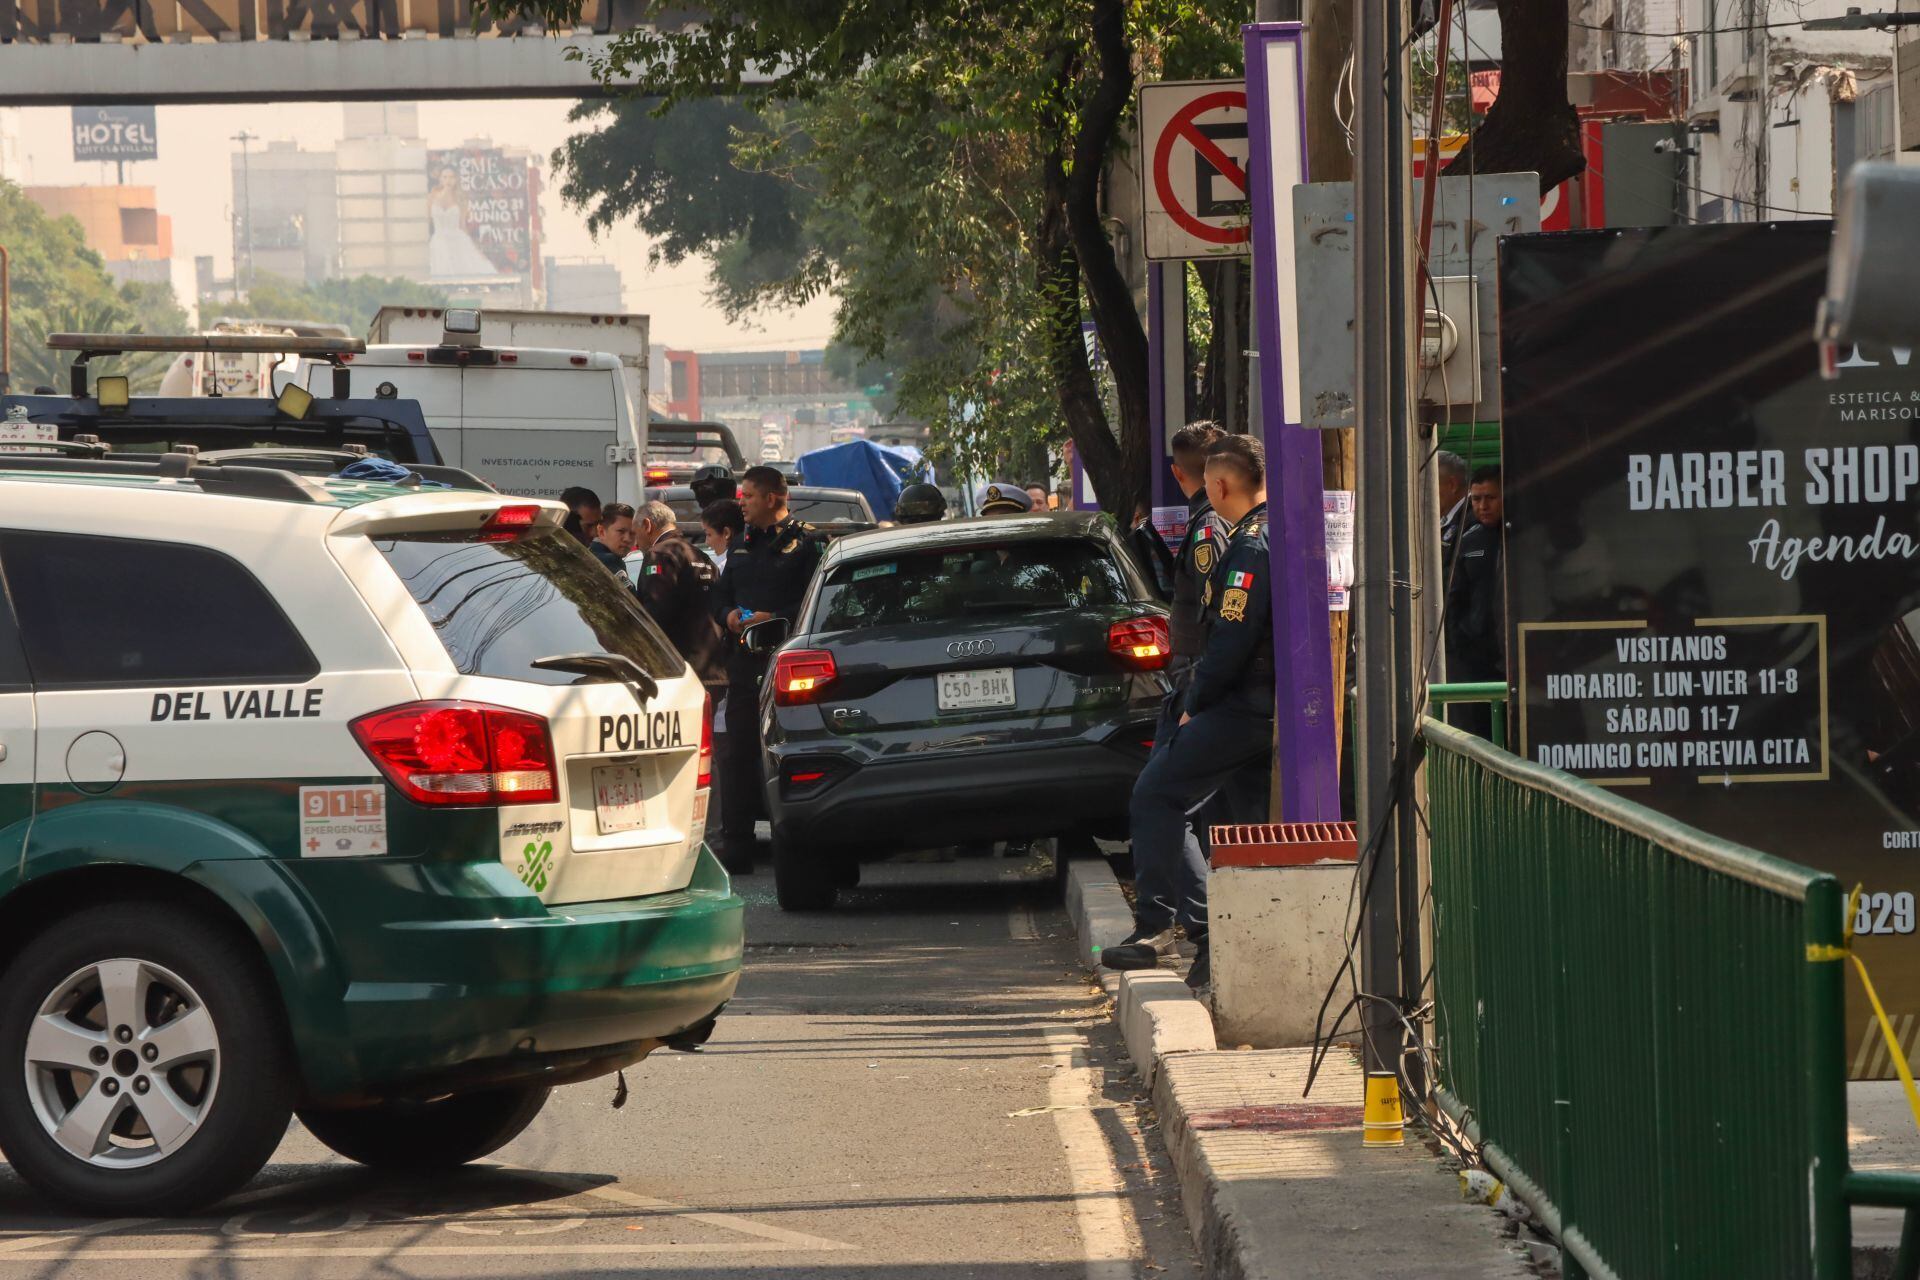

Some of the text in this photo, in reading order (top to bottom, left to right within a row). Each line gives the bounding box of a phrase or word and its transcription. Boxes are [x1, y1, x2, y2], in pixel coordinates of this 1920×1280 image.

[76, 123, 154, 145] HOTEL
[470, 157, 500, 174] ME
[470, 173, 523, 191] CASO
[467, 199, 508, 211] MAYO
[466, 211, 511, 223] JUNIO
[491, 227, 524, 243] WTC
[1829, 391, 1902, 405] ESTETICA
[1841, 407, 1920, 421] MARISOL
[481, 457, 594, 468] INVESTIGACIÓN FORENSE
[535, 473, 541, 481] Y
[1627, 445, 1919, 510] BARBER SHOP
[1748, 515, 1919, 581] Agenda
[1616, 635, 1727, 663] VISITANOS
[943, 677, 1010, 699] C50-BHK
[1546, 668, 1798, 699] HORARIO: LUN-VIER 11-8
[150, 688, 324, 722] DEL VALLE
[833, 708, 861, 719] Q2
[1606, 704, 1740, 733] SÁBADO 11-7
[600, 711, 682, 752] POLICIA
[1538, 738, 1810, 769] DOMINGO CON PREVIA CITA
[309, 793, 374, 815] 911
[304, 824, 384, 834] EMERGENCIAS
[1883, 831, 1920, 848] CORT
